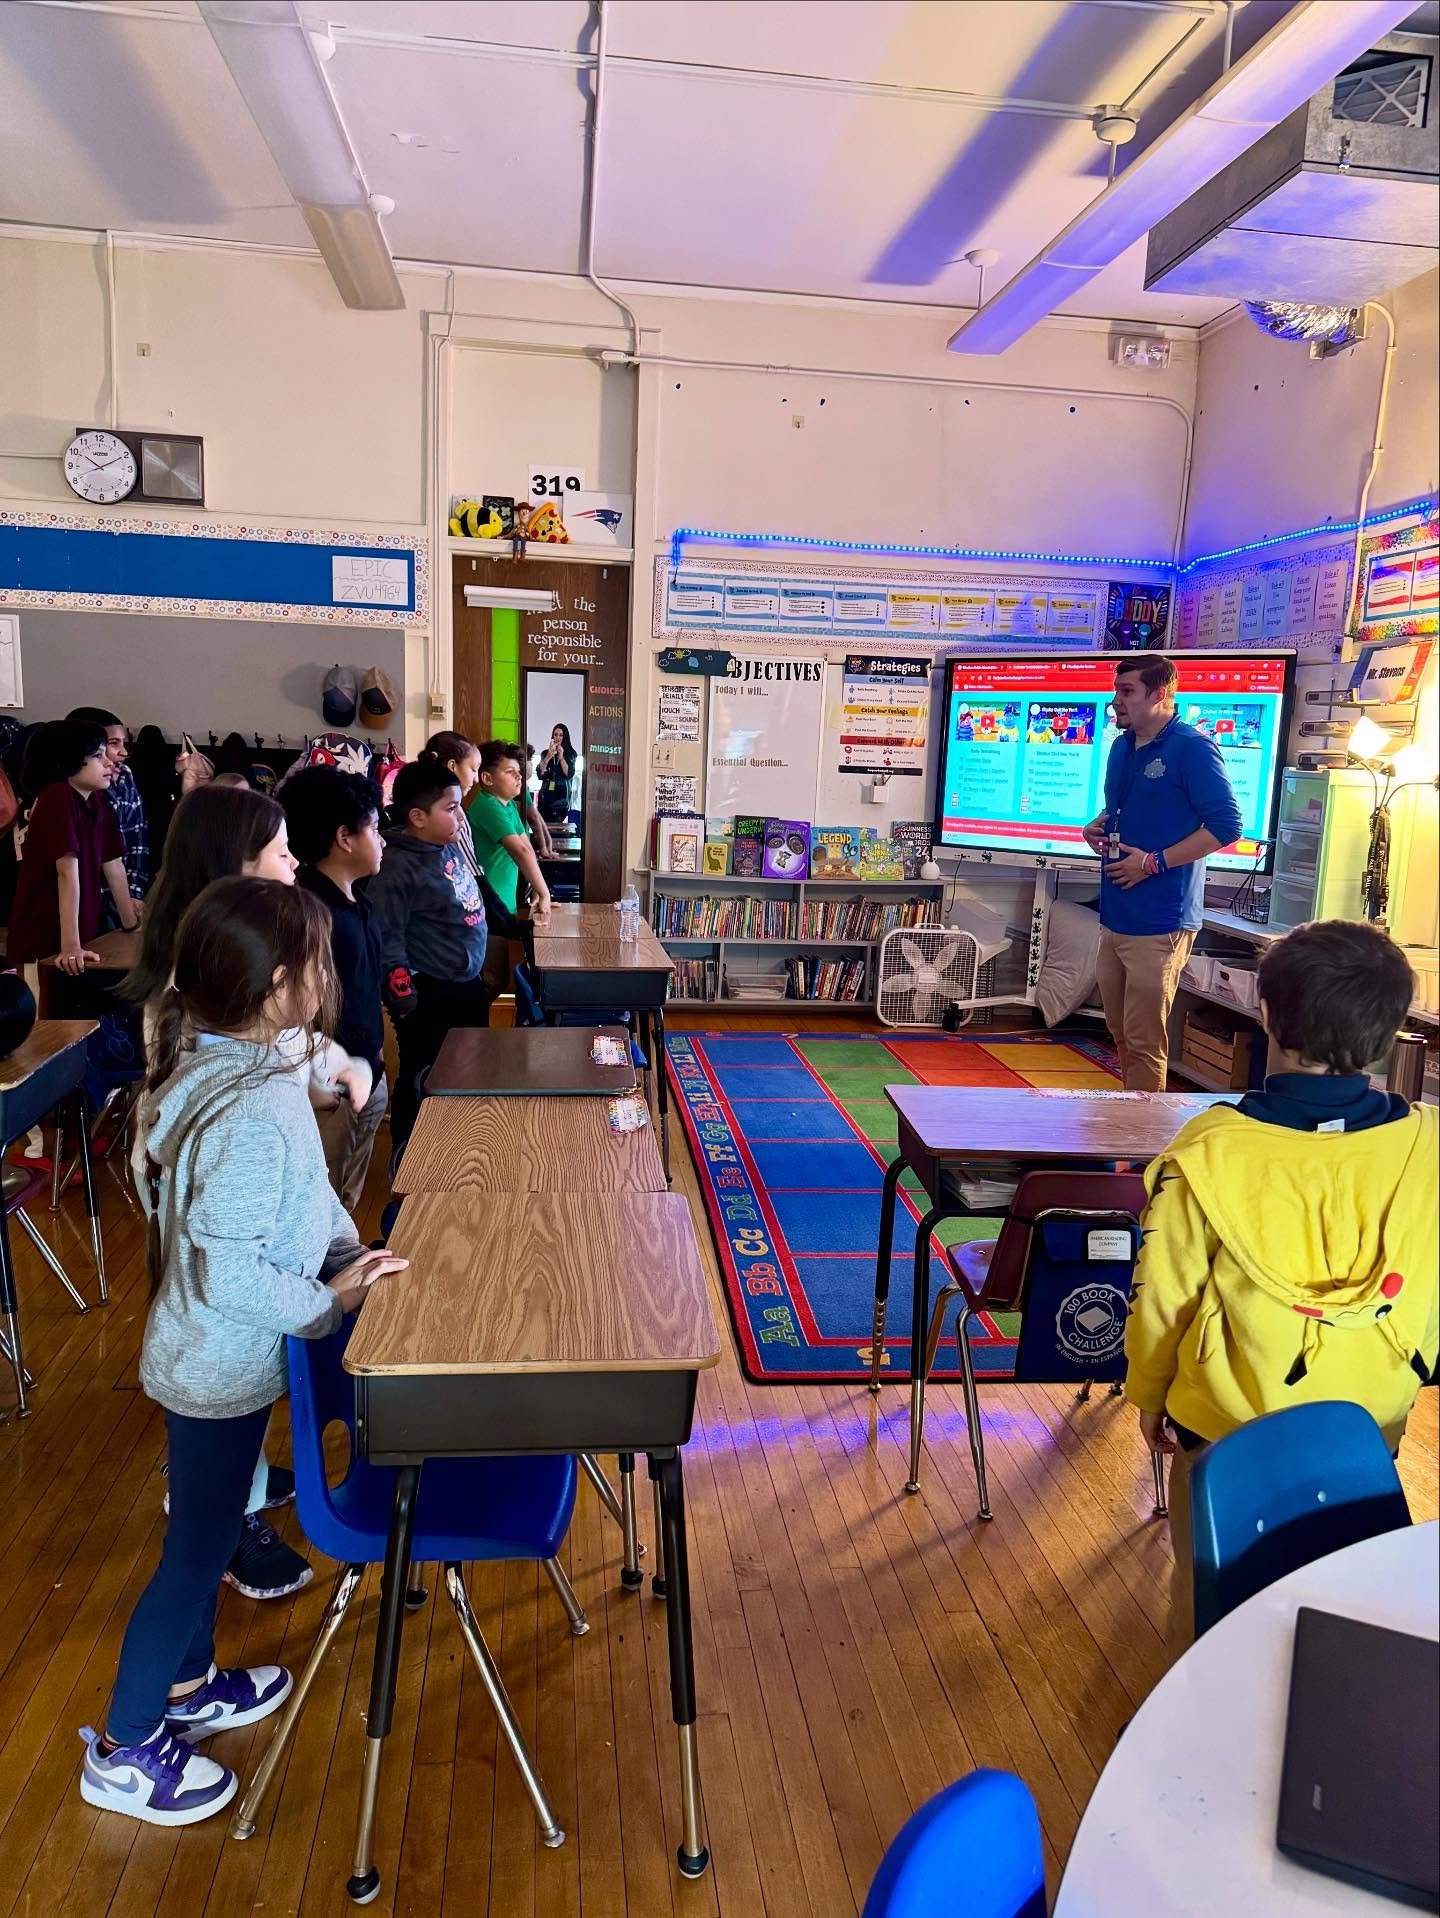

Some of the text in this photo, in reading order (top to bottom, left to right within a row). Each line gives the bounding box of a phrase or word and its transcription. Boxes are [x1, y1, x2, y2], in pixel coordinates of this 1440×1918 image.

[94, 434, 105, 442] 12
[69, 448, 79, 456] 10
[123, 451, 129, 459] 2
[68, 462, 74, 470] 9
[72, 477, 79, 485] 8
[532, 474, 581, 496] 319
[351, 559, 393, 578] EPIC
[574, 597, 596, 612] the
[1114, 599, 1162, 622] BUDDY
[543, 619, 588, 632] person
[528, 634, 602, 648] responsible
[538, 647, 558, 662] for
[730, 660, 822, 681] BJECTIVES
[871, 660, 921, 675] Strategies
[1366, 667, 1406, 680] Mr. Stevens
[589, 686, 625, 695] CHOICES
[715, 685, 738, 695] Today
[740, 686, 744, 695] I
[589, 705, 624, 717] ACTIONS
[888, 708, 909, 716] Feelings
[712, 758, 747, 767] Essential
[737, 826, 765, 834] UNDERW
[900, 832, 931, 840] WORLD
[818, 833, 852, 844] LEGEND
[692, 1104, 722, 1121] Hh
[700, 1122, 730, 1142] Gg
[705, 1143, 737, 1162] Ff
[716, 1167, 747, 1189] Ee
[720, 1194, 757, 1221] Dd
[732, 1227, 769, 1256] Cc
[743, 1262, 783, 1296] Bb
[1064, 1289, 1116, 1314] 100 BOOK
[759, 1305, 800, 1347] Aa
[1068, 1320, 1124, 1349] CHALLENGE
[1061, 1347, 1084, 1364] ENGLISH
